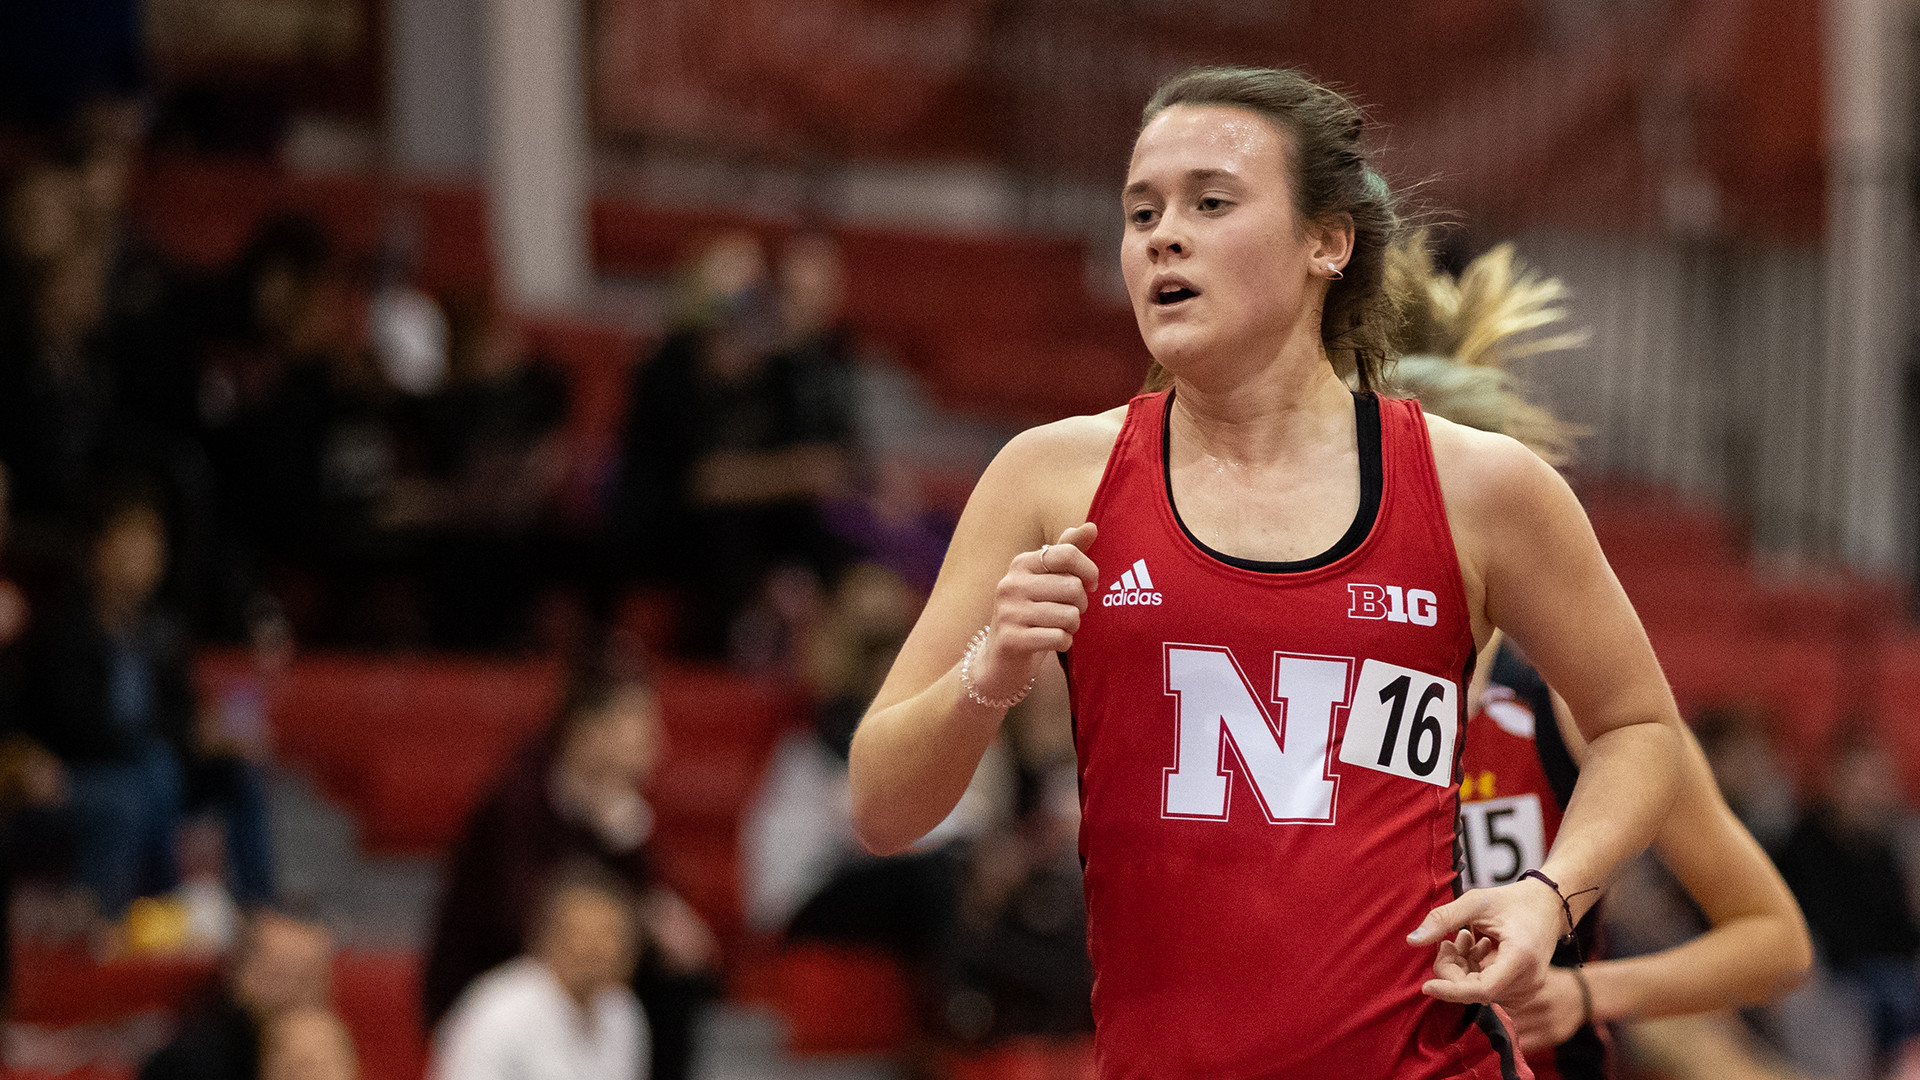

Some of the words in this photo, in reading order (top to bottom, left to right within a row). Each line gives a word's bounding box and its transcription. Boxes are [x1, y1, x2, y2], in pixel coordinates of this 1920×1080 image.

[1103, 588, 1163, 607] adidas
[1161, 641, 1355, 825] N
[1377, 675, 1446, 777] 16
